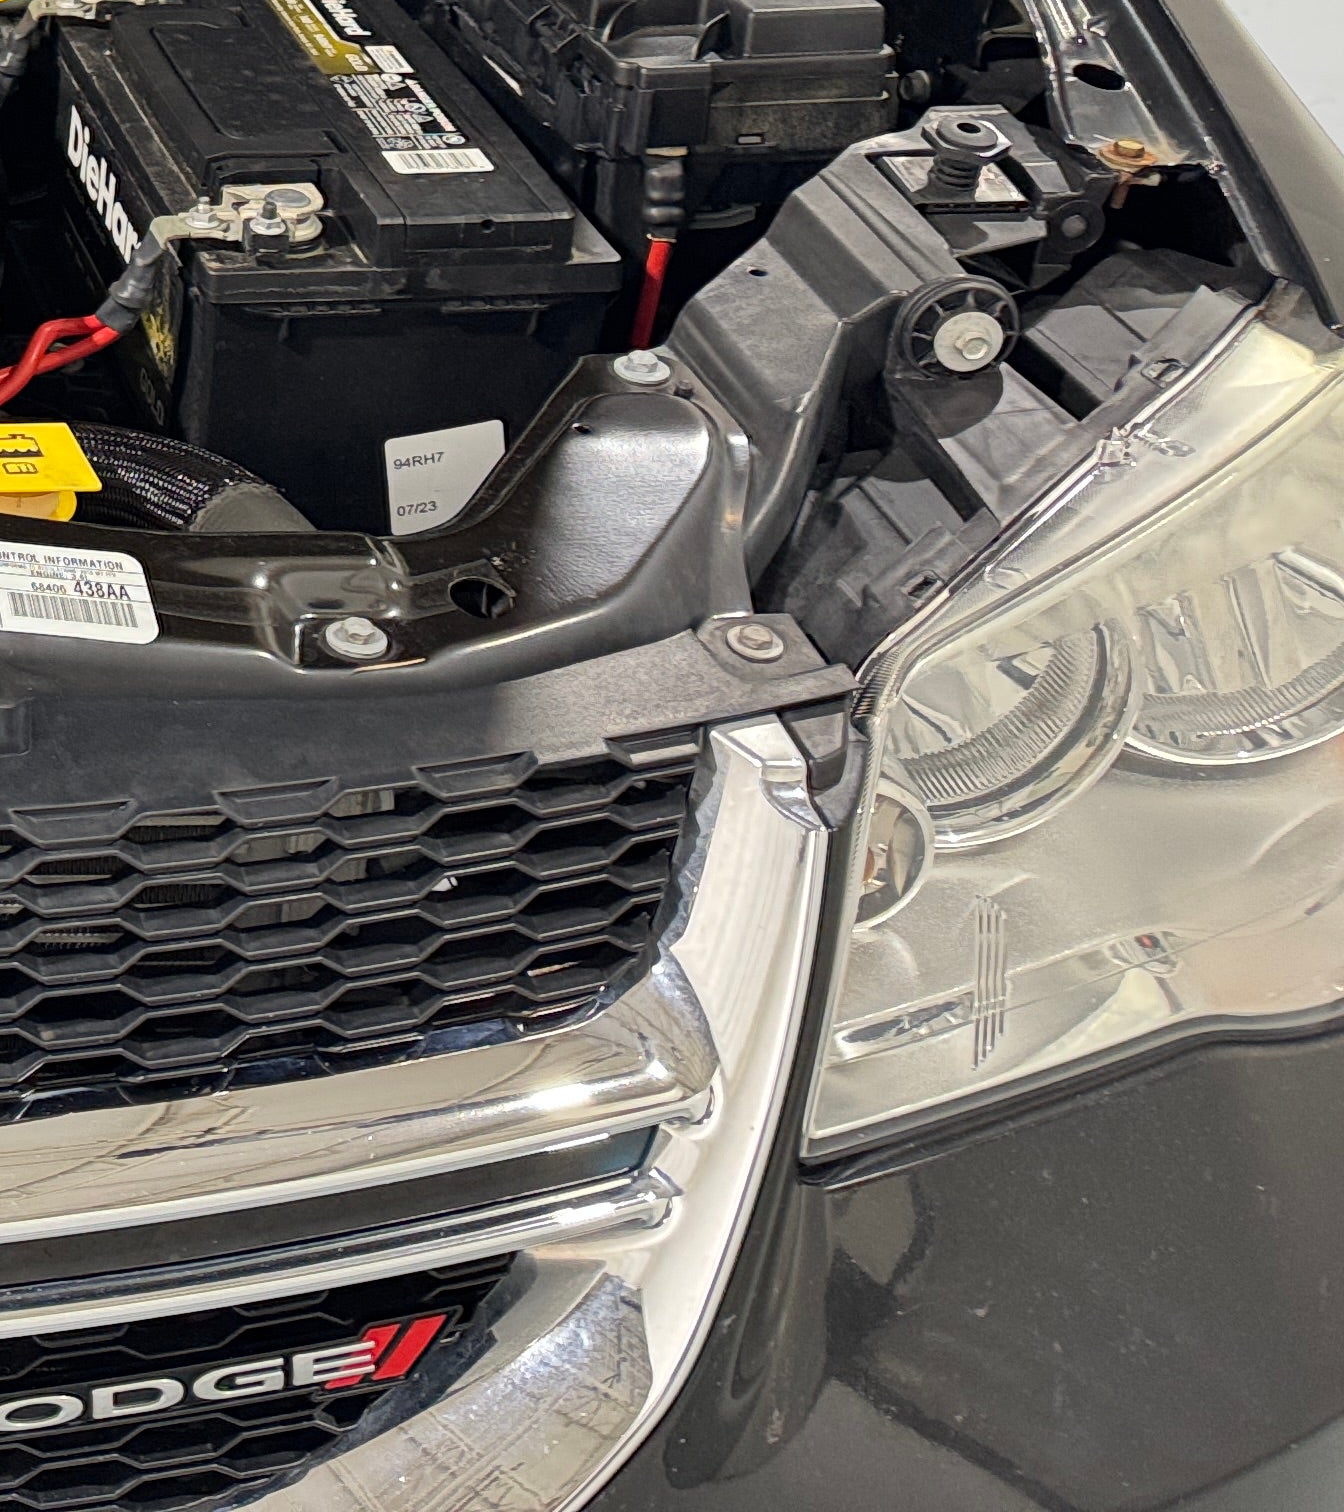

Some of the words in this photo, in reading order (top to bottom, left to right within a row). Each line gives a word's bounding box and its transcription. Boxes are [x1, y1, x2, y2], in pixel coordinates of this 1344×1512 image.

[67, 104, 143, 265] DieHar
[393, 451, 445, 470] 94RH7
[396, 500, 438, 517] 07/23
[43, 555, 124, 571] INFORMATION
[73, 580, 132, 601] 438AA
